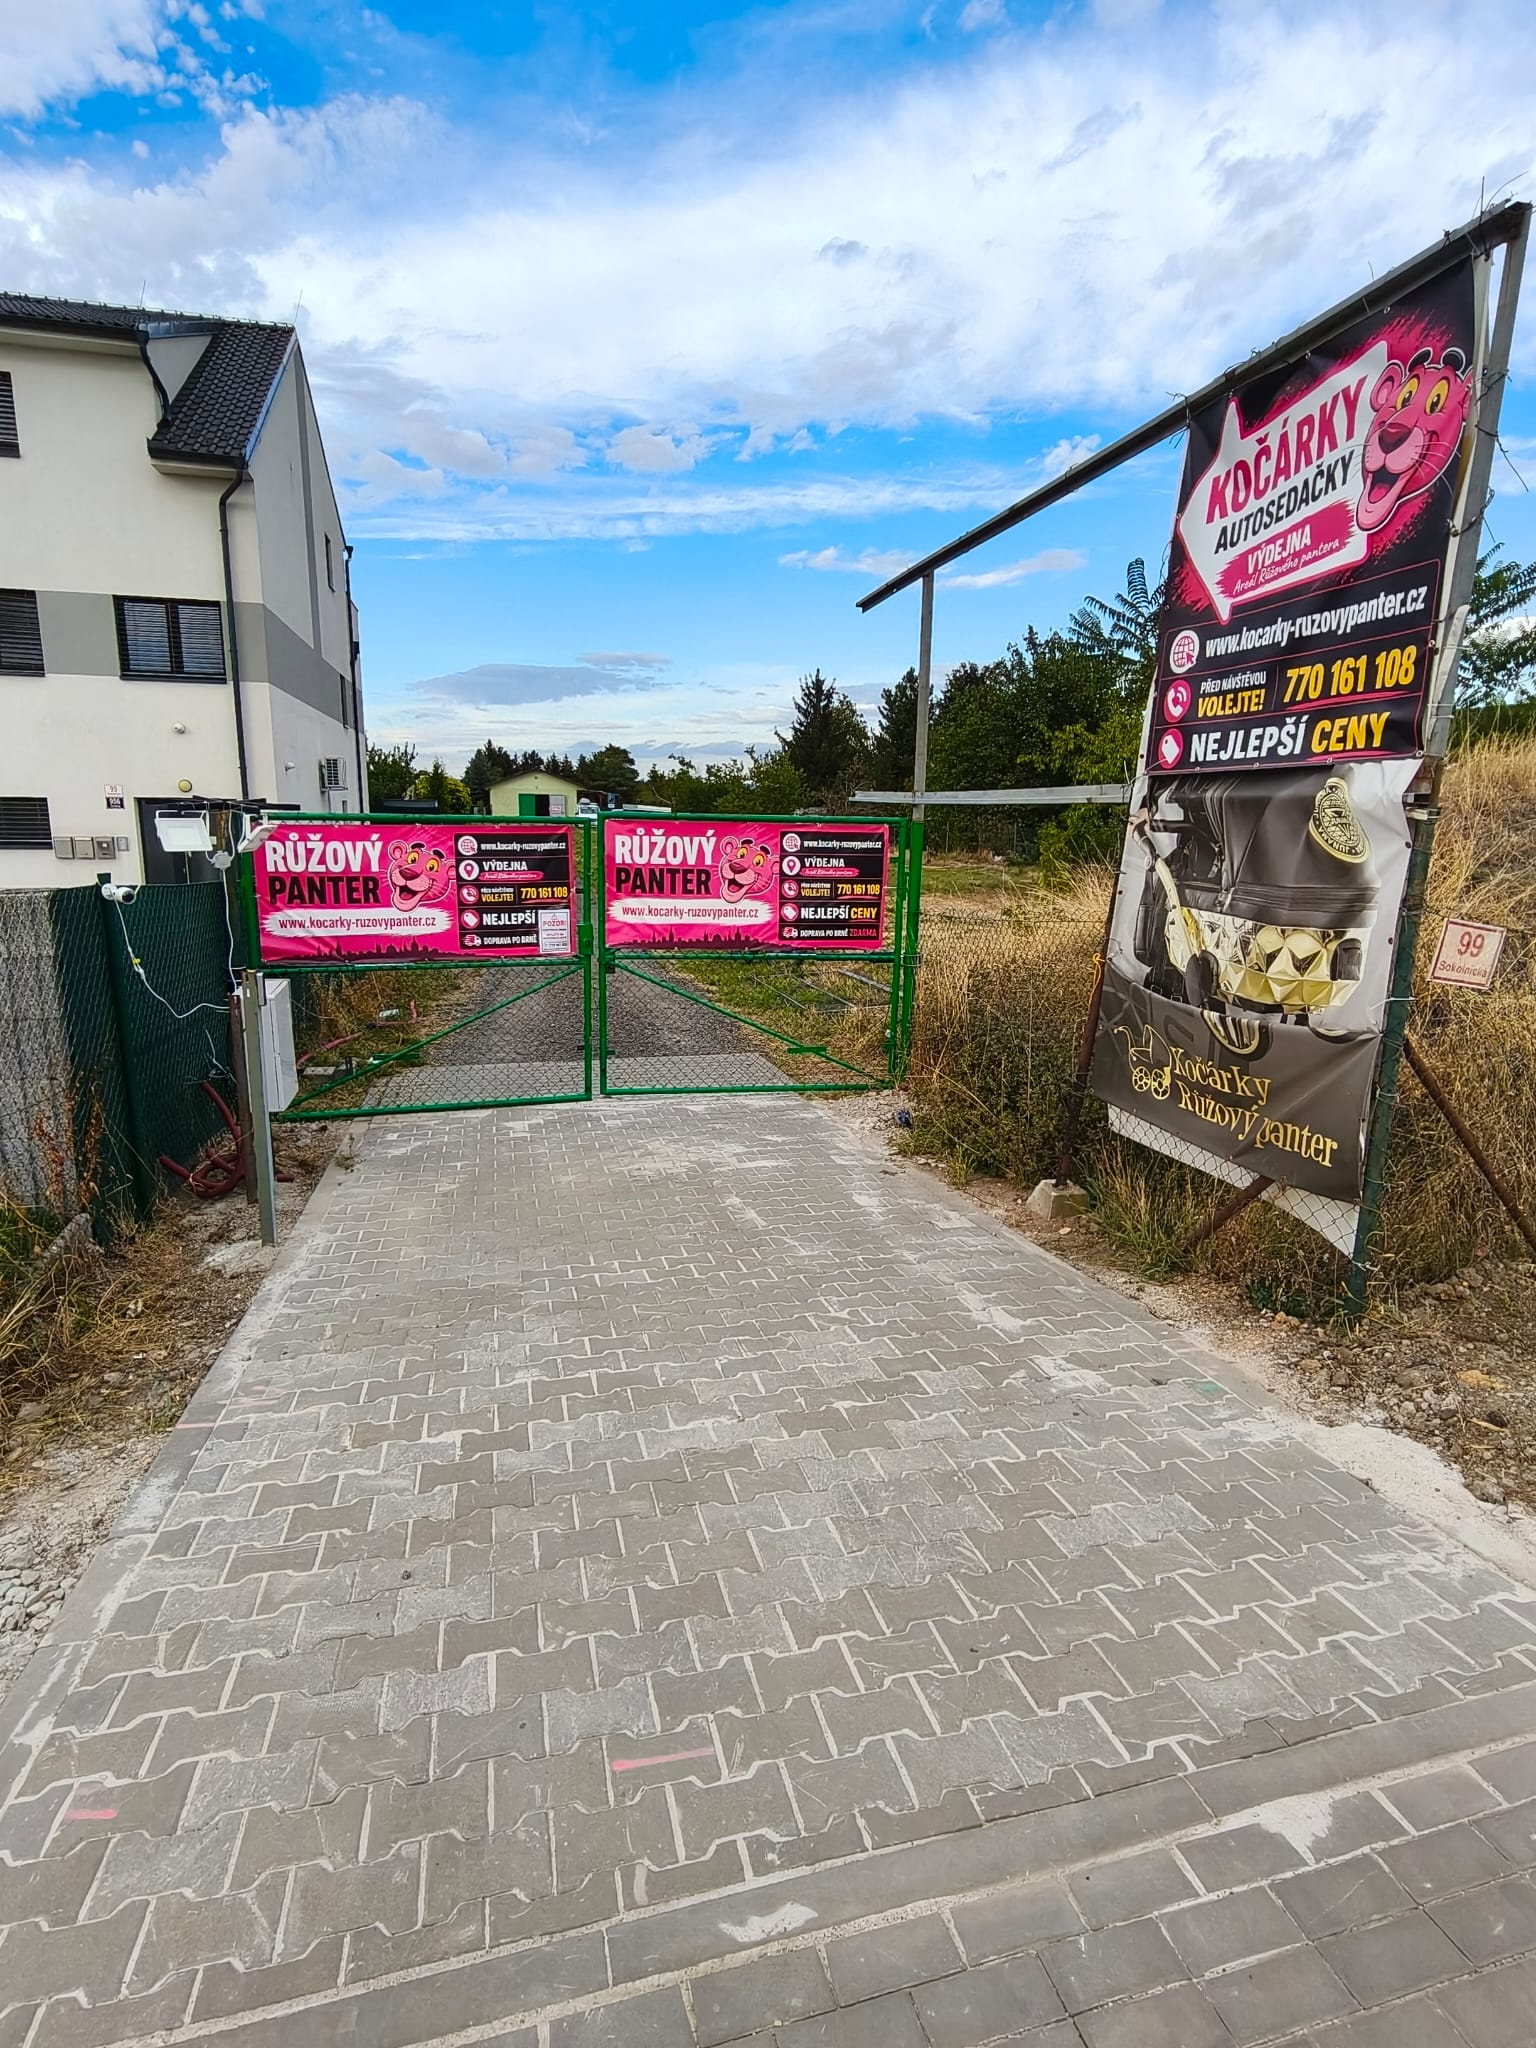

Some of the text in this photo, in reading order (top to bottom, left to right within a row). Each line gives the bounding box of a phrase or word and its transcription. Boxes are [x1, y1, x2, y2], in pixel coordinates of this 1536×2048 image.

[1205, 374, 1369, 525] KOČÁRKY
[1214, 450, 1355, 554] AUTOSEDAČKY
[1247, 523, 1311, 574] VÝDEJNA
[1299, 539, 1339, 569] pantera
[1205, 585, 1428, 658] www.kocarky-ruzovypanter.cz
[1200, 670, 1267, 694] PŘED NÁVŠTĚVOU
[1282, 644, 1417, 703] 770 161 108
[1197, 688, 1265, 718] VOLEJTE!
[1190, 711, 1391, 763] NEJLEPŠÍ CENY
[265, 832, 383, 873] RŮŽOVÝ
[615, 829, 716, 866] RŮŽOVÝ
[804, 856, 845, 867] VÝDEJNA
[482, 860, 528, 871] VÝDEJNA
[269, 876, 381, 905] PANTER
[521, 887, 568, 899] 770 161 108
[615, 867, 712, 895] PANTER
[837, 884, 880, 895] 770 161 108
[278, 911, 436, 932] www.kocarky-ruzovypanter.cz
[482, 910, 536, 926] NEJLEPŠÍ
[622, 904, 759, 921] www.kocarky-ruzovypanter.cz
[800, 905, 877, 919] NEJLEPŠÍ CENY
[1457, 931, 1485, 958] 99
[1170, 1046, 1272, 1106] Kočárky
[1254, 1116, 1338, 1168] panter
